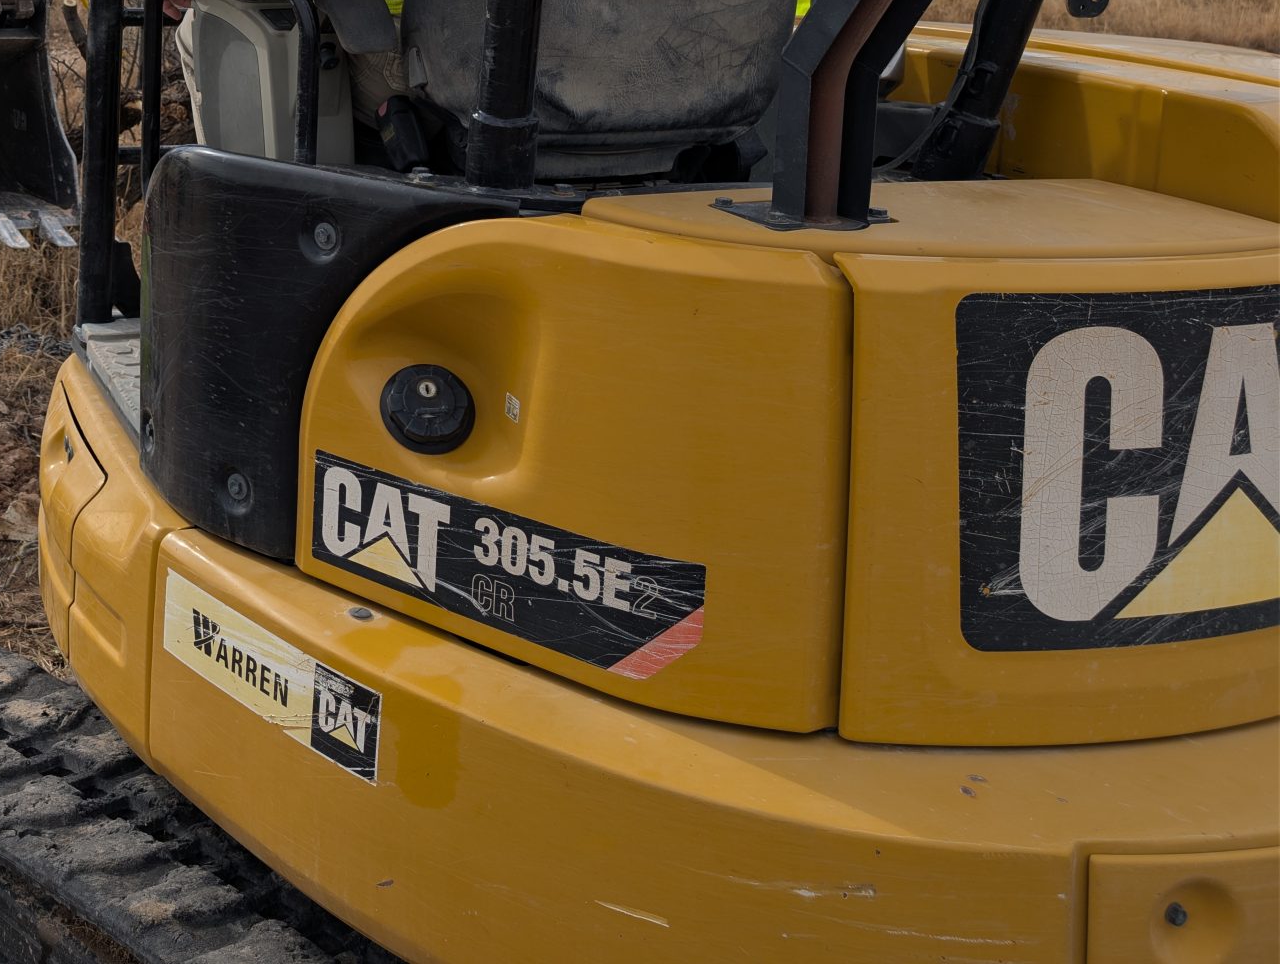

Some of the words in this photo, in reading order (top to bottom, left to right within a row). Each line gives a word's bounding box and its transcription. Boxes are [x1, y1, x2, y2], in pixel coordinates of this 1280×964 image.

[322, 465, 451, 593] CAT
[471, 573, 516, 623] CR
[192, 607, 289, 708] WARREN
[318, 688, 371, 754] CAT
